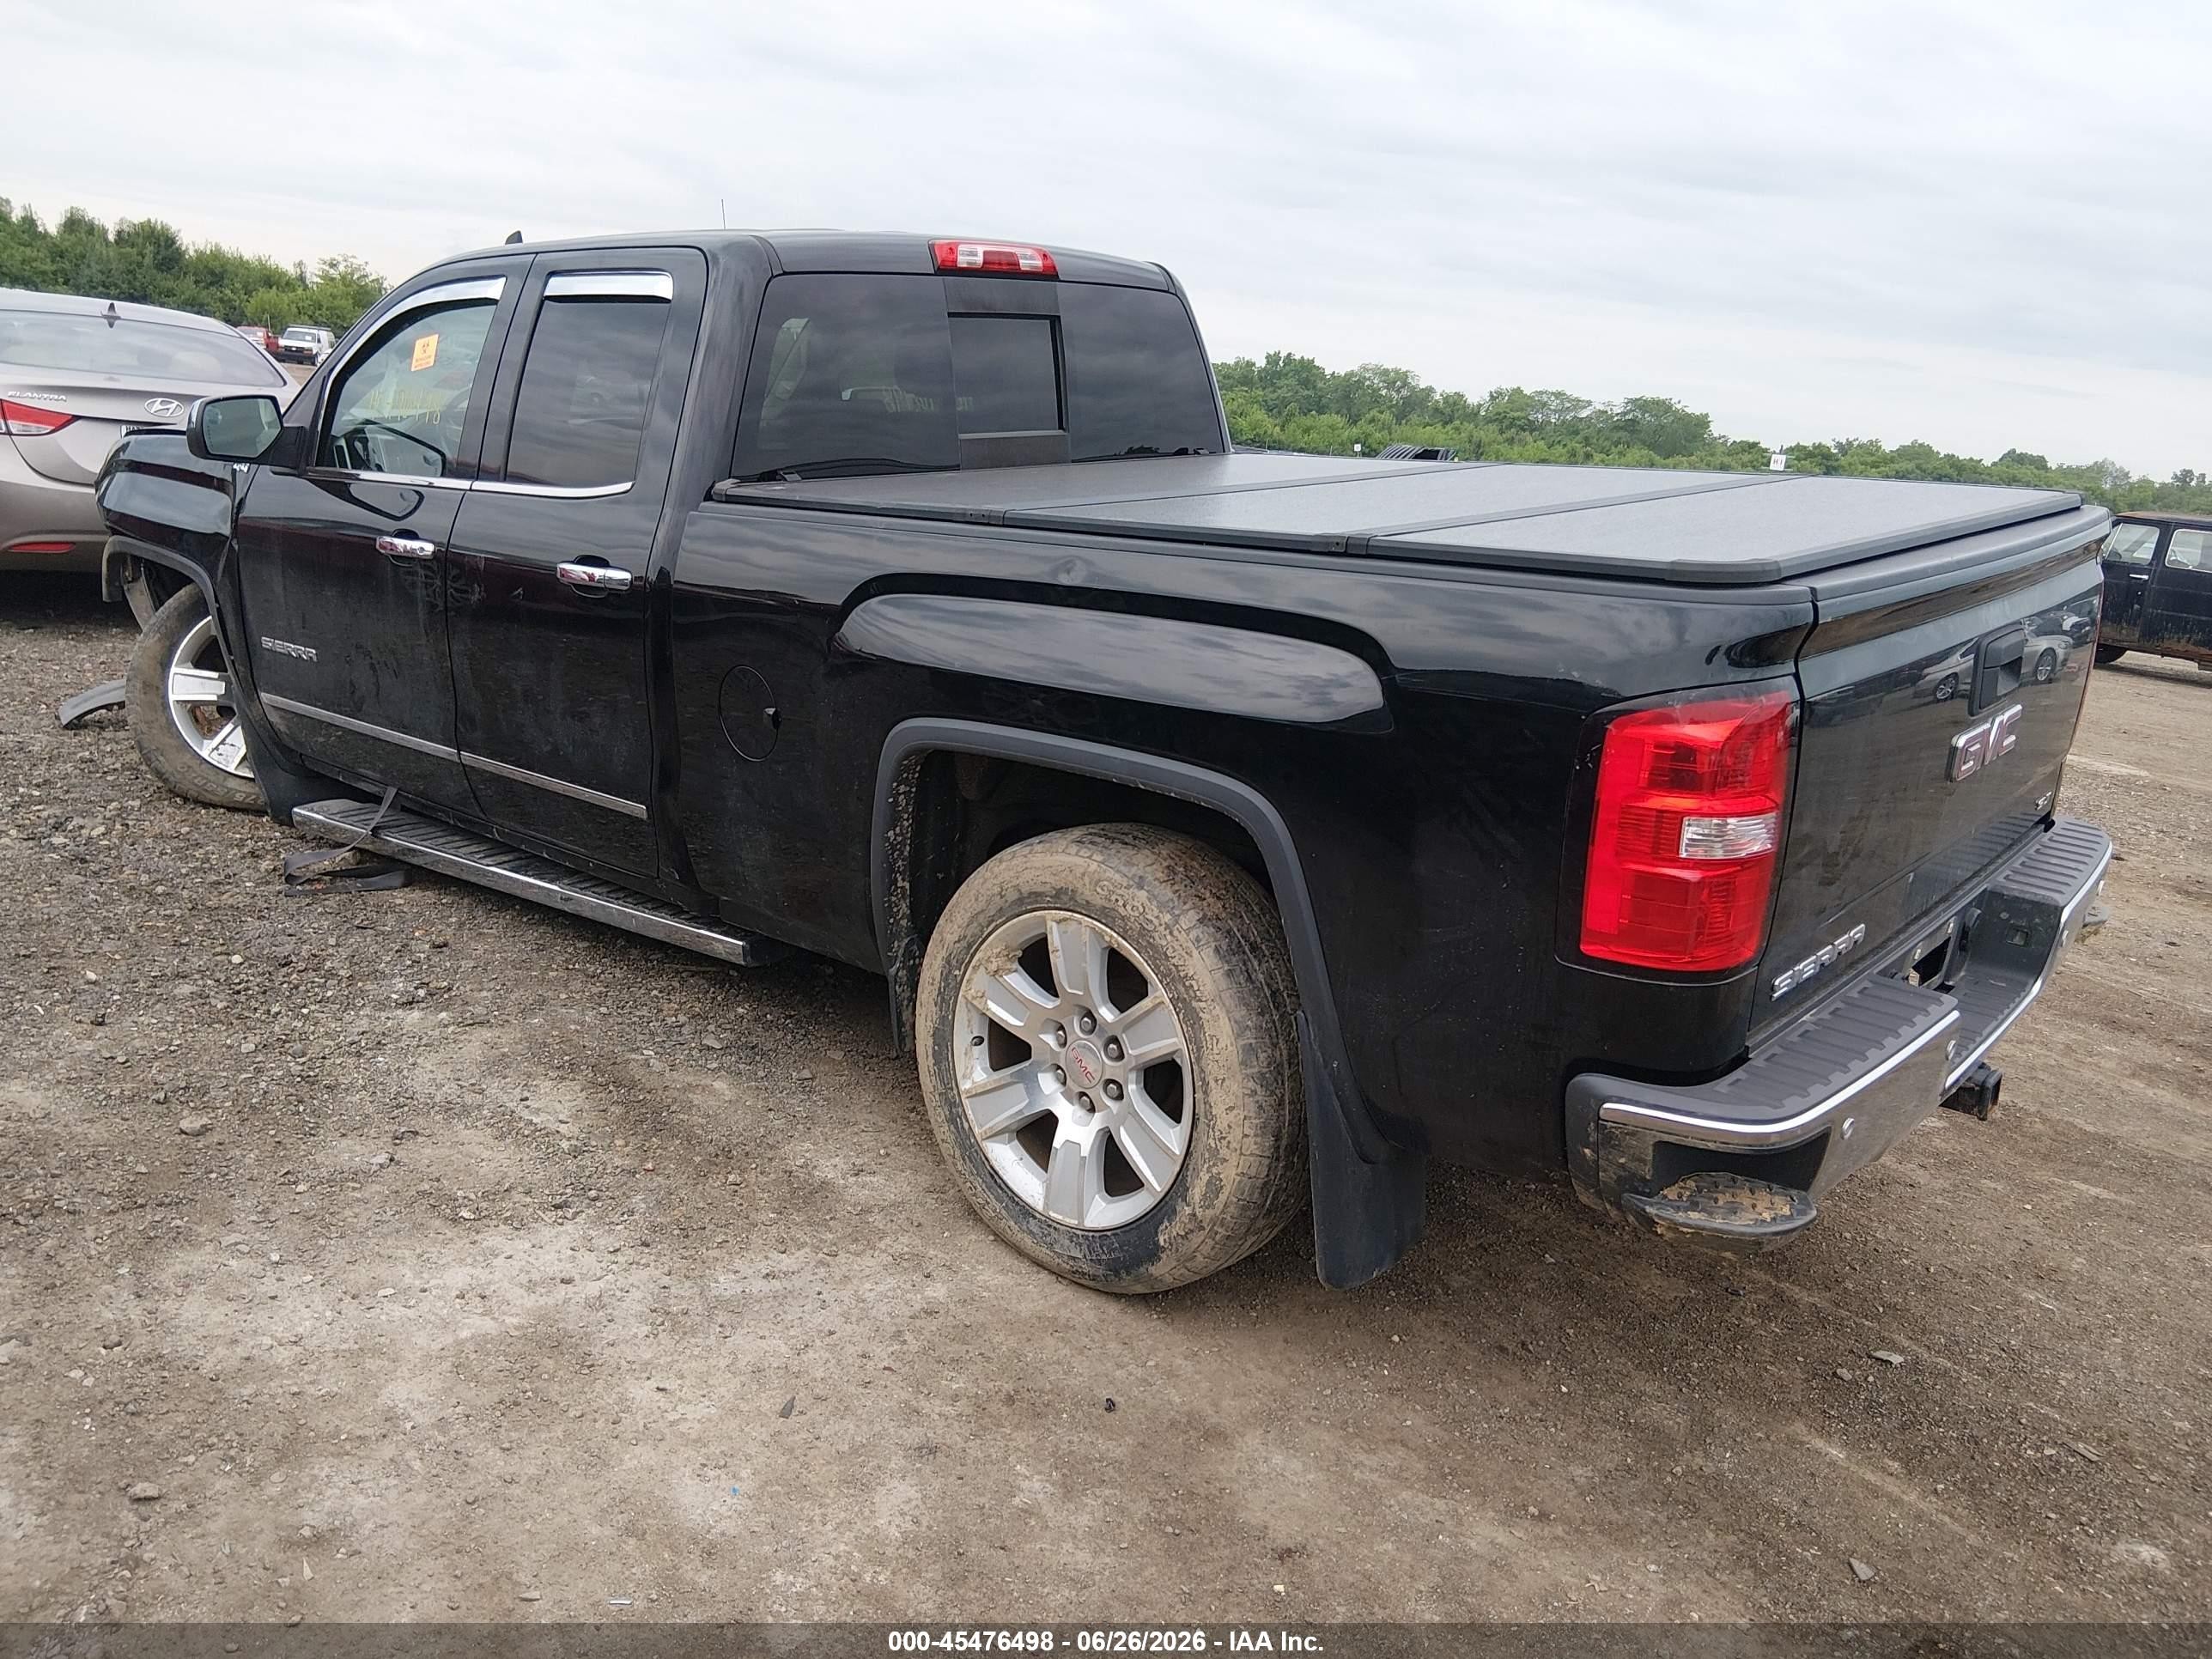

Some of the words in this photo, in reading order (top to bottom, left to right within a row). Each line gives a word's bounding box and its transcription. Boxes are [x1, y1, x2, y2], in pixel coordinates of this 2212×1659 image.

[8, 391, 67, 402] ELANTRA
[261, 636, 318, 662] SIERRA
[1951, 704, 2023, 782] GMC
[1771, 923, 1866, 1001] SIERRA
[1071, 1047, 1096, 1084] GMC
